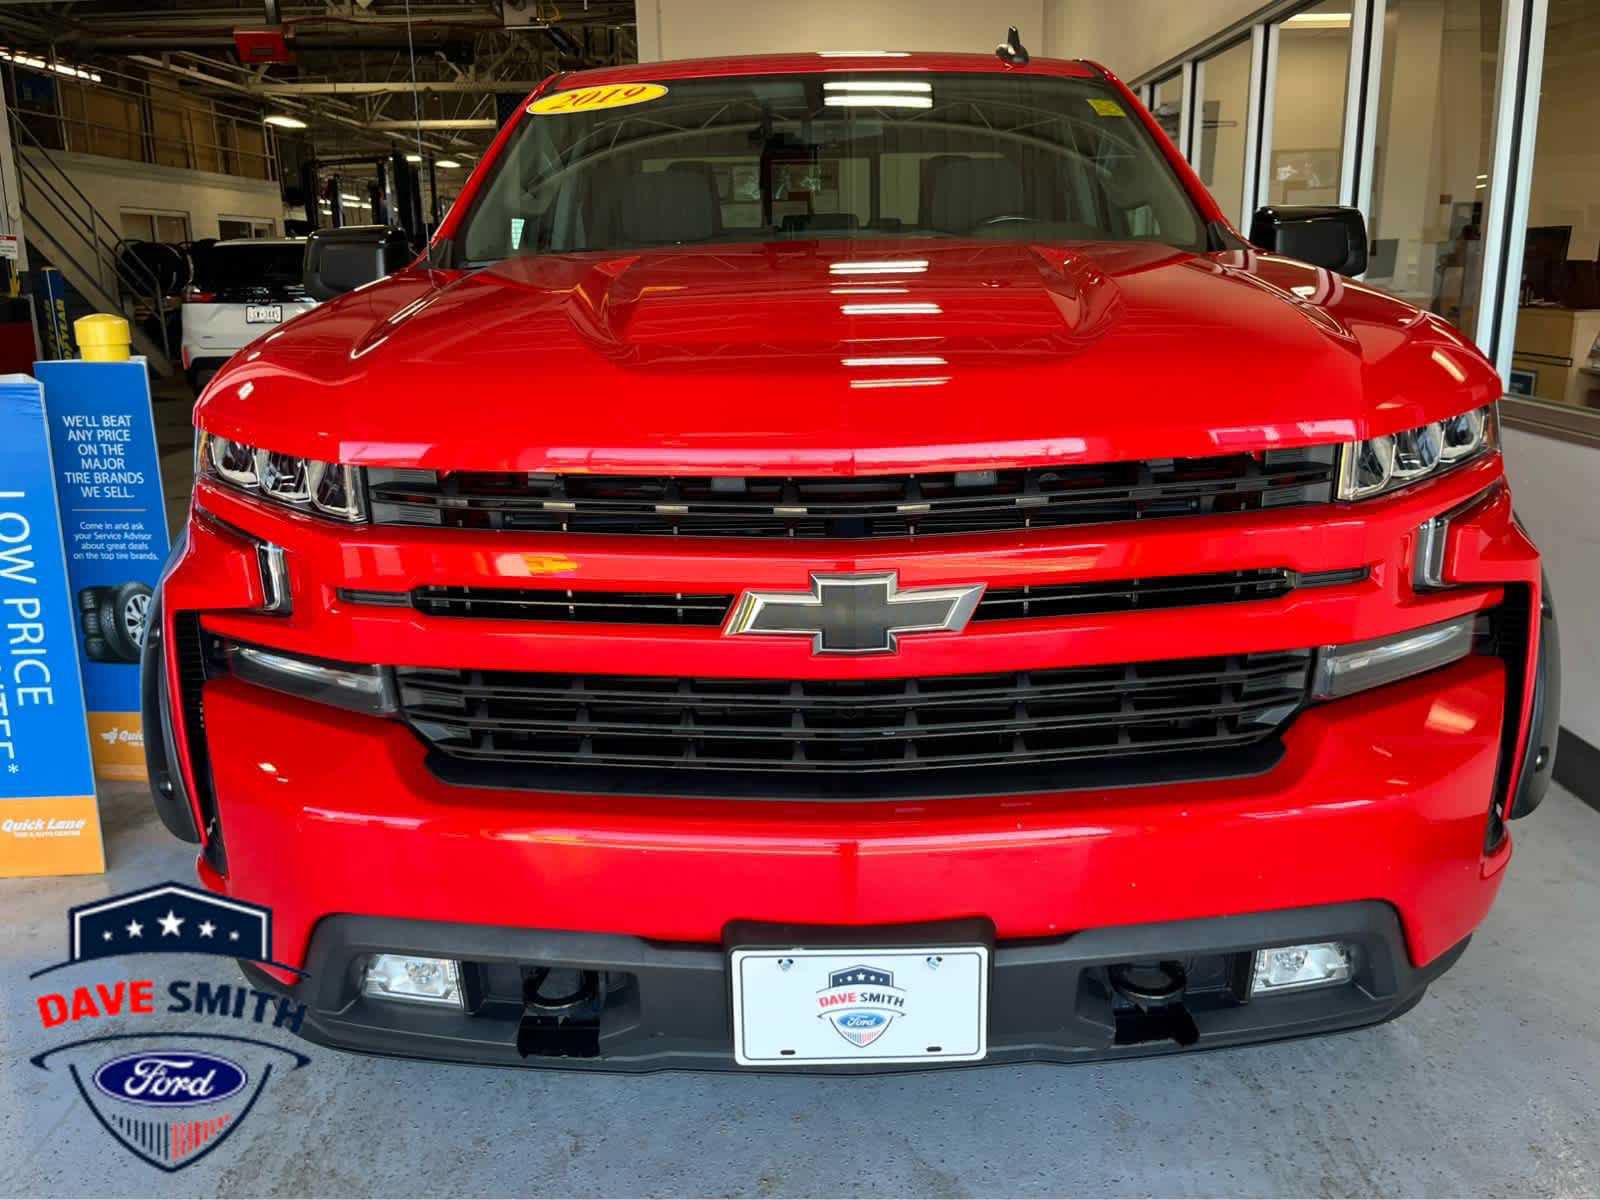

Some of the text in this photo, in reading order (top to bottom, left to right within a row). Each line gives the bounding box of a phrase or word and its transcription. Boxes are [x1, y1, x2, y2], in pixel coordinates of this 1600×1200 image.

[549, 86, 647, 111] 2019
[62, 415, 132, 427] WE'LL BEAT
[68, 429, 131, 441] ANY PRICE
[78, 444, 125, 455] ON THE
[81, 458, 126, 470] MAJOR
[64, 472, 145, 484] TIRE BRANDS
[80, 486, 135, 498] WE SELL.
[80, 521, 144, 530] Come in and ask
[73, 532, 152, 542] your Service Advisor
[81, 542, 149, 552] about great deals
[85, 552, 99, 560] the
[101, 552, 114, 561] top
[116, 552, 128, 560] tire
[130, 552, 159, 560] brands.
[5, 598, 53, 705] PRICE
[2, 818, 86, 832] Quick Lane
[819, 992, 905, 1008] DAVE SMITH
[846, 1014, 877, 1027] Ford
